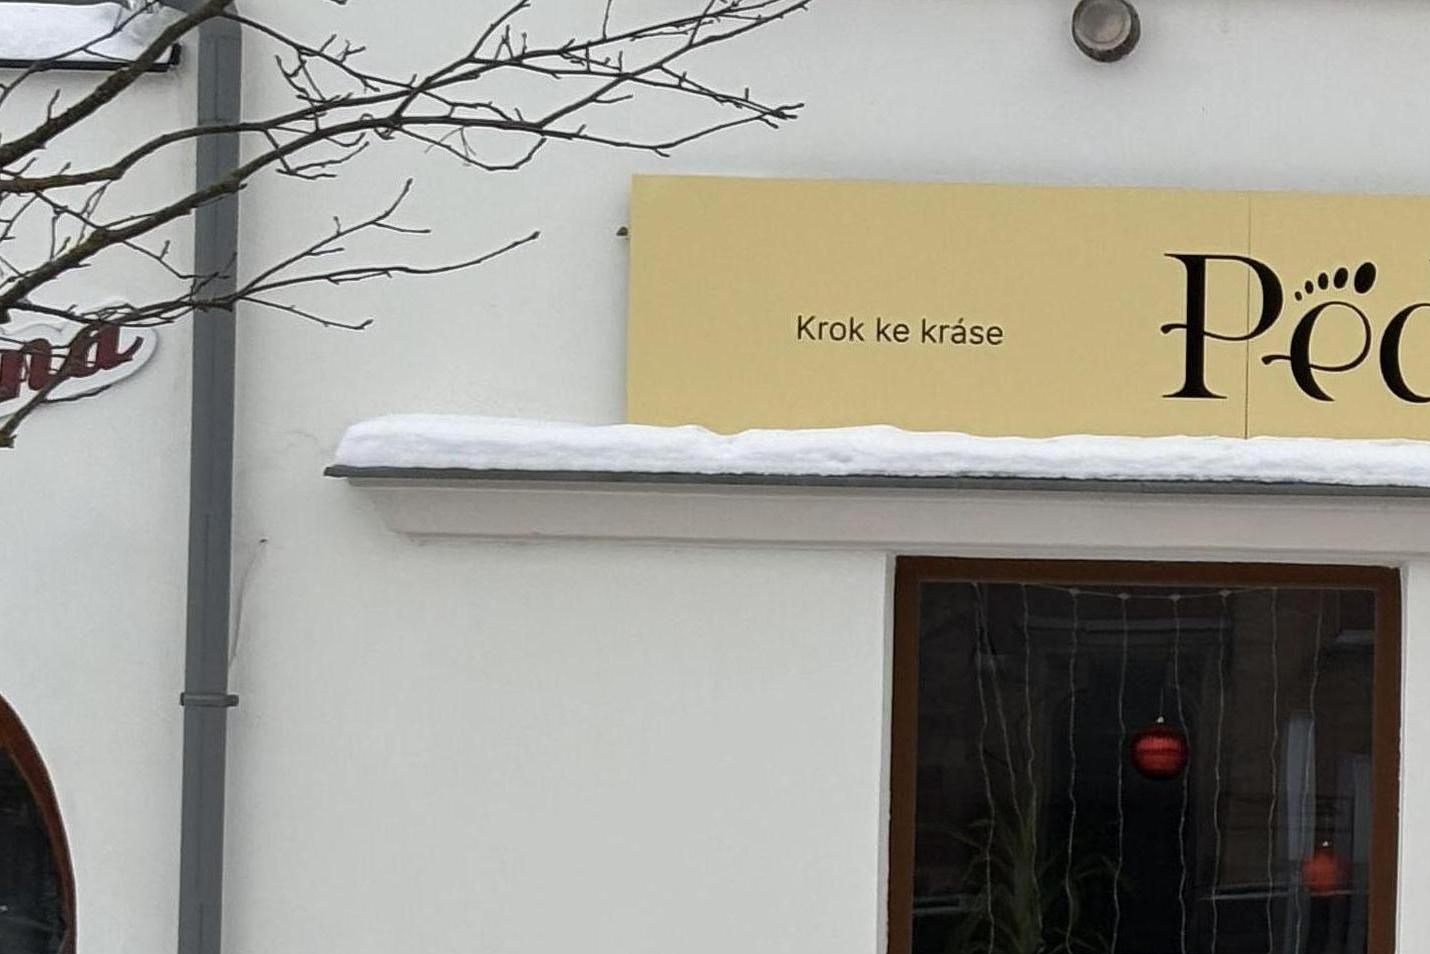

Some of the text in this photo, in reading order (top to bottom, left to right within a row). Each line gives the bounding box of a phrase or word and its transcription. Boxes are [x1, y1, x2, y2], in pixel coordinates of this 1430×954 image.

[797, 315, 1004, 345] Krok ke kráse
